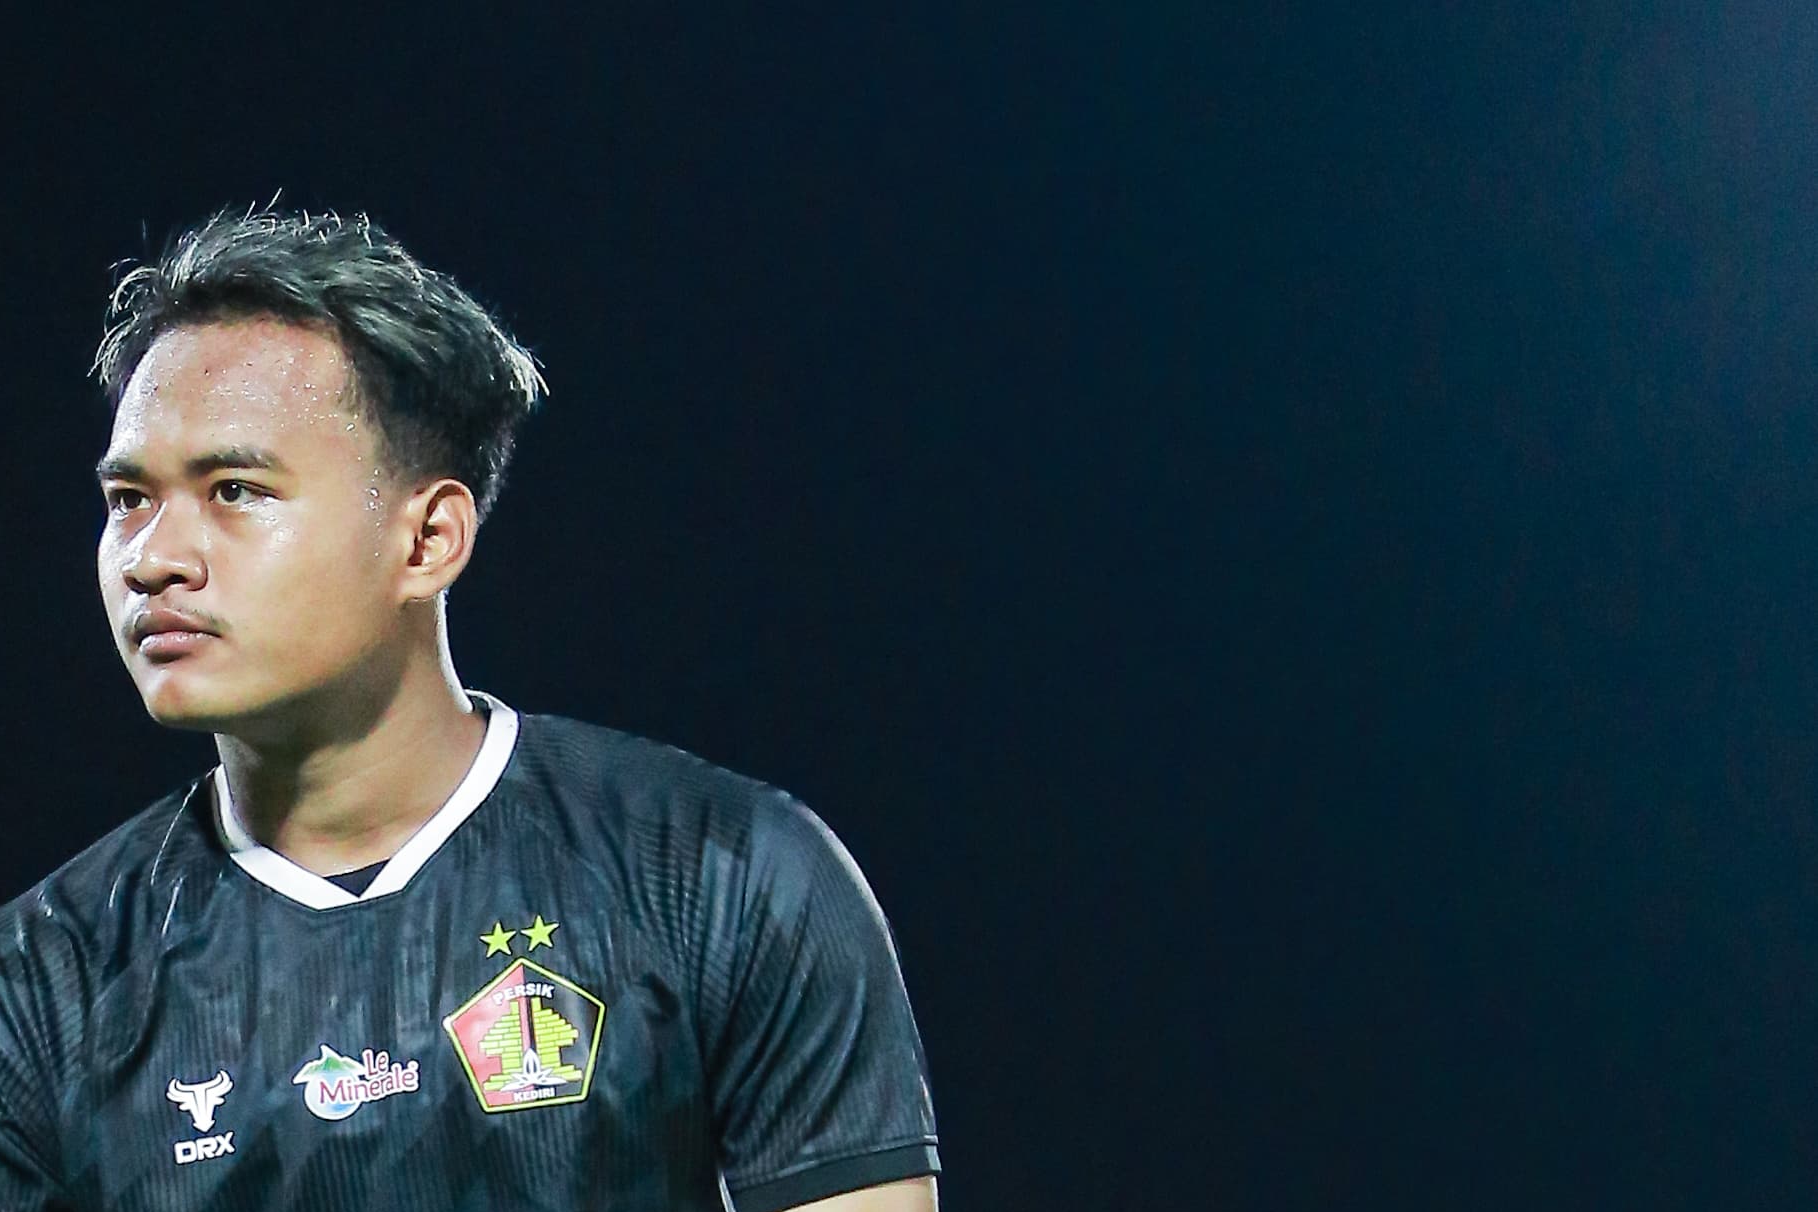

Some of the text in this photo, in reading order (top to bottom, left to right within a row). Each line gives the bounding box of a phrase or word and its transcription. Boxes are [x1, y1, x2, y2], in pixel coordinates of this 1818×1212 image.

[492, 983, 555, 1005] PERSIK
[365, 1051, 387, 1076] Le
[320, 1065, 416, 1104] Minerale
[513, 1087, 555, 1102] KEDIRI
[173, 1131, 236, 1164] DRX
